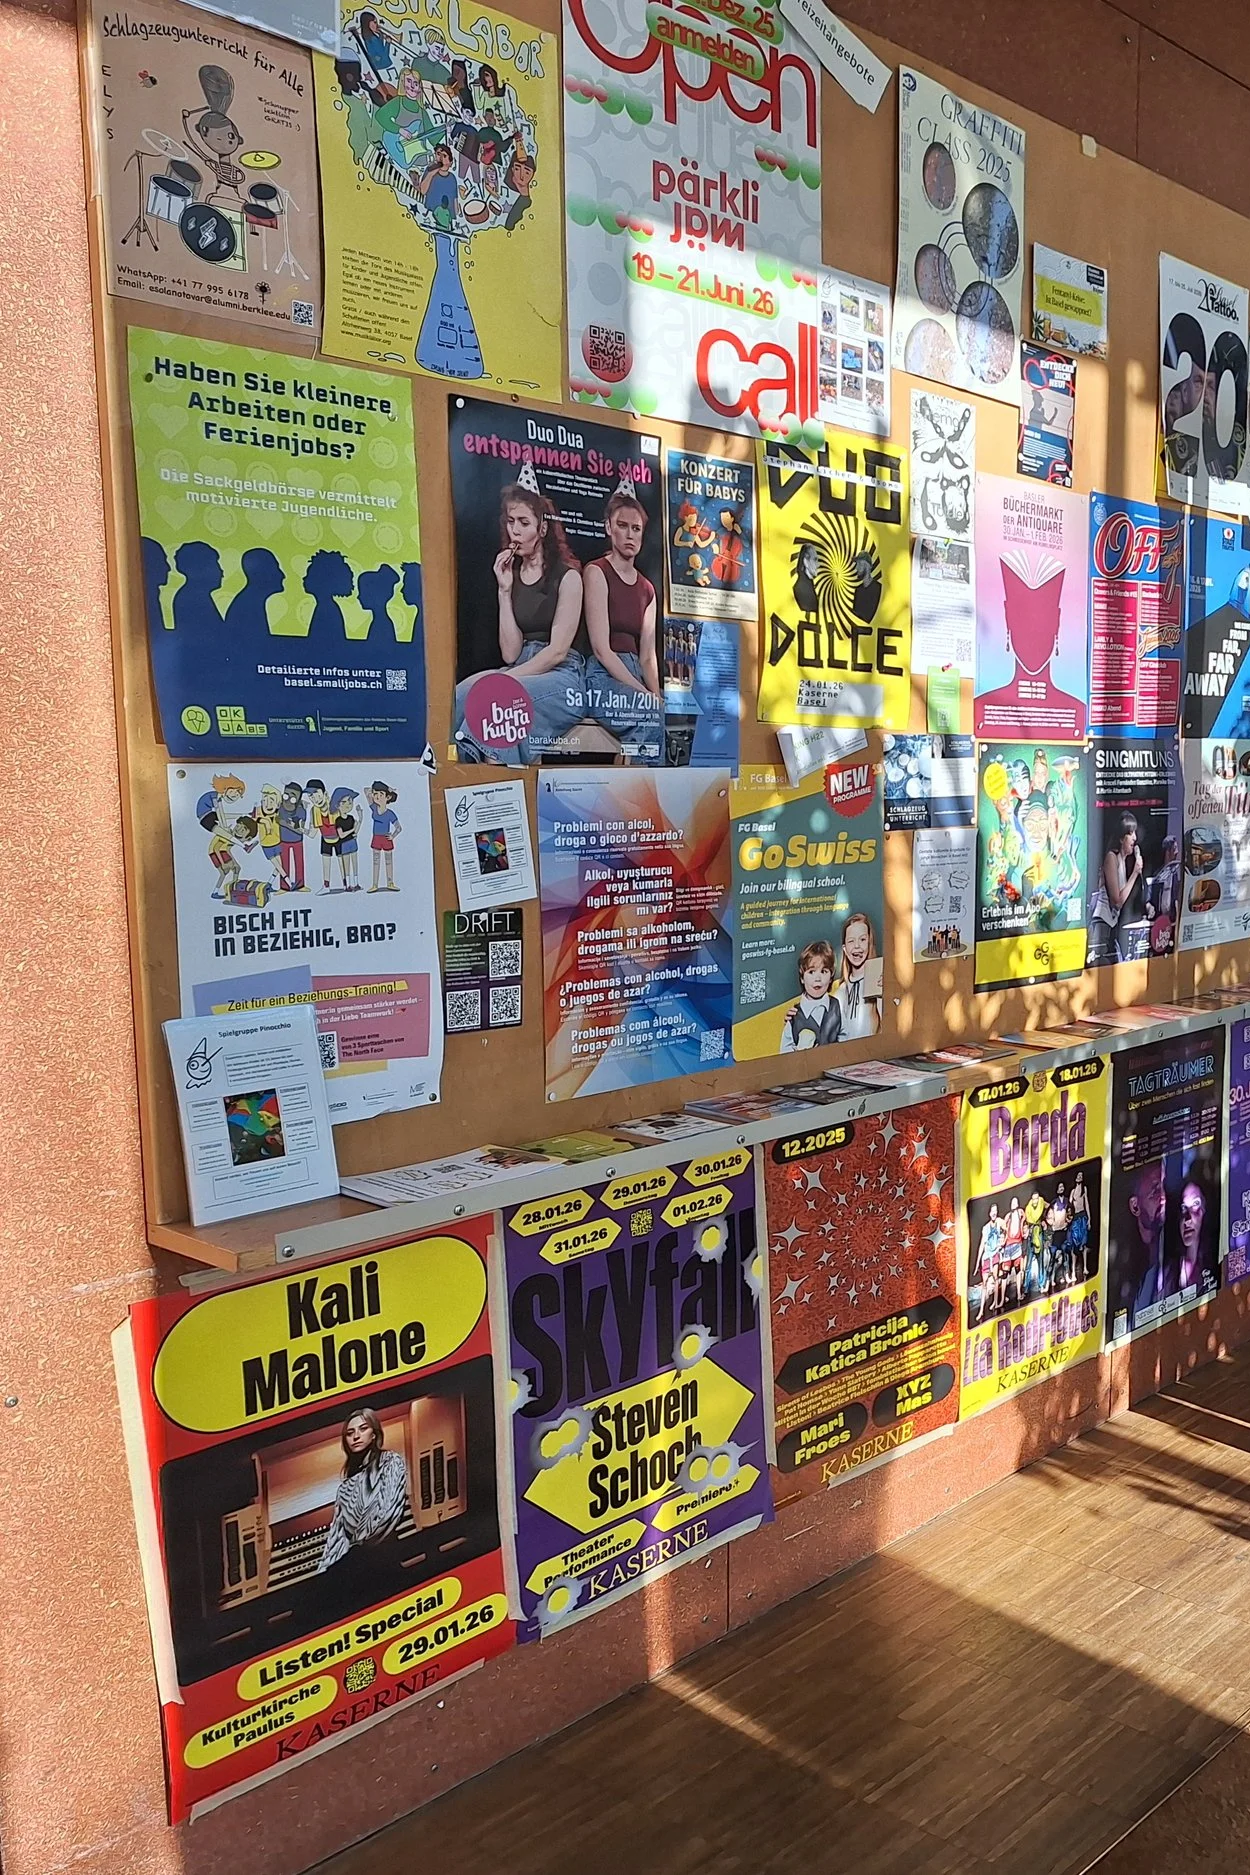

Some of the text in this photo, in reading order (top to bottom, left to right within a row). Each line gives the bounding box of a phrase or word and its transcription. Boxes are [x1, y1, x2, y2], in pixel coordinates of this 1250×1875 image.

[448, 0, 544, 78] LABOR
[656, 15, 755, 74] anmelden
[104, 13, 304, 97] Schlagzeugunterricht für Alle
[941, 94, 1022, 155] GRAFFITI
[918, 116, 1012, 182] CLASS 2025
[653, 156, 760, 224] pärkli
[632, 251, 654, 281] 19
[117, 264, 249, 300] WhatsApp: 995 6178
[117, 277, 144, 290] Email:
[155, 356, 392, 414] Haben Sie kleinere
[1054, 370, 1071, 380] DICH
[188, 391, 367, 436] Arbeiten oder
[204, 422, 355, 460] Ferienjobs?
[527, 419, 584, 448] Duo Dua
[463, 433, 613, 476] entspannen Sie
[763, 455, 809, 470] Stephan
[680, 459, 740, 483] KONZERT
[766, 441, 901, 525] DUO
[677, 477, 745, 502] FÜR BABYS
[1024, 491, 1045, 503] BASLER
[1003, 496, 1063, 521] BÜCHERMARKT
[1003, 514, 1062, 534] DER ANTIQUARE
[769, 613, 903, 676] DOLCE
[323, 667, 382, 678] Infos unter
[1208, 652, 1234, 674] FAR
[798, 689, 838, 698] Kaserne
[800, 680, 843, 690] 24.01.26
[1184, 673, 1228, 696] AWAY
[797, 697, 827, 707] Basel
[1095, 750, 1175, 768] SINGMITUNS
[830, 764, 869, 795] NEW
[1193, 781, 1210, 798] Tag
[1211, 785, 1222, 794] der
[833, 786, 871, 804] PROGRAMME
[1188, 800, 1223, 819] offenen
[606, 821, 624, 831] con
[752, 822, 776, 832] Basel
[554, 834, 586, 848] droga
[740, 875, 846, 894] Join our bilingual school.
[214, 909, 312, 935] BISCH FIT
[454, 911, 514, 934] DRIFT
[981, 915, 1029, 932] verschenken
[982, 904, 1041, 919] Erlebnis im Abo
[243, 923, 396, 954] BEZIEHIG, BRO?
[624, 963, 718, 984] con drogas
[228, 981, 399, 1011] Zeit für ein Beziehungs-Training!
[608, 990, 620, 999] de
[360, 1009, 394, 1020] Teamwork!
[218, 1022, 291, 1038] Spielgruppe Pinocchio
[626, 1023, 697, 1049] jogos de azar?
[1059, 1063, 1097, 1083] 18.01.26
[1128, 1054, 1214, 1097] TAGTRÄUMER
[977, 1081, 1020, 1102] 17.01.26
[1128, 1091, 1175, 1110] Über Menschen
[1229, 1086, 1245, 1105] 30.
[782, 1127, 846, 1158] 12.2025
[989, 1090, 1087, 1187] Borda
[695, 1154, 742, 1177] 30.01.26
[613, 1176, 666, 1200] 29.01.26
[522, 1200, 582, 1226] 28.01.26
[673, 1194, 722, 1218] 01.02.26
[554, 1228, 607, 1253] 31.01.26
[286, 1260, 382, 1340] Kali
[829, 1315, 908, 1357] Patricija
[963, 1289, 1098, 1387] Lia Rodrigues
[242, 1321, 426, 1418] Malone
[806, 1349, 868, 1384] Katica
[996, 1345, 1069, 1393] KASERNE
[896, 1374, 932, 1400] XYZ
[896, 1391, 932, 1417] Mas
[591, 1379, 699, 1460] Steven
[801, 1413, 844, 1446] Mari
[795, 1430, 850, 1466] Froes
[821, 1421, 914, 1483] KASERNE
[562, 1534, 614, 1565] Theater
[588, 1519, 708, 1600] KASERNE
[259, 1590, 446, 1687] Listen! Special
[398, 1605, 494, 1664] 29.01.26
[202, 1681, 322, 1746] Kulturkirche
[232, 1710, 296, 1748] Paulus
